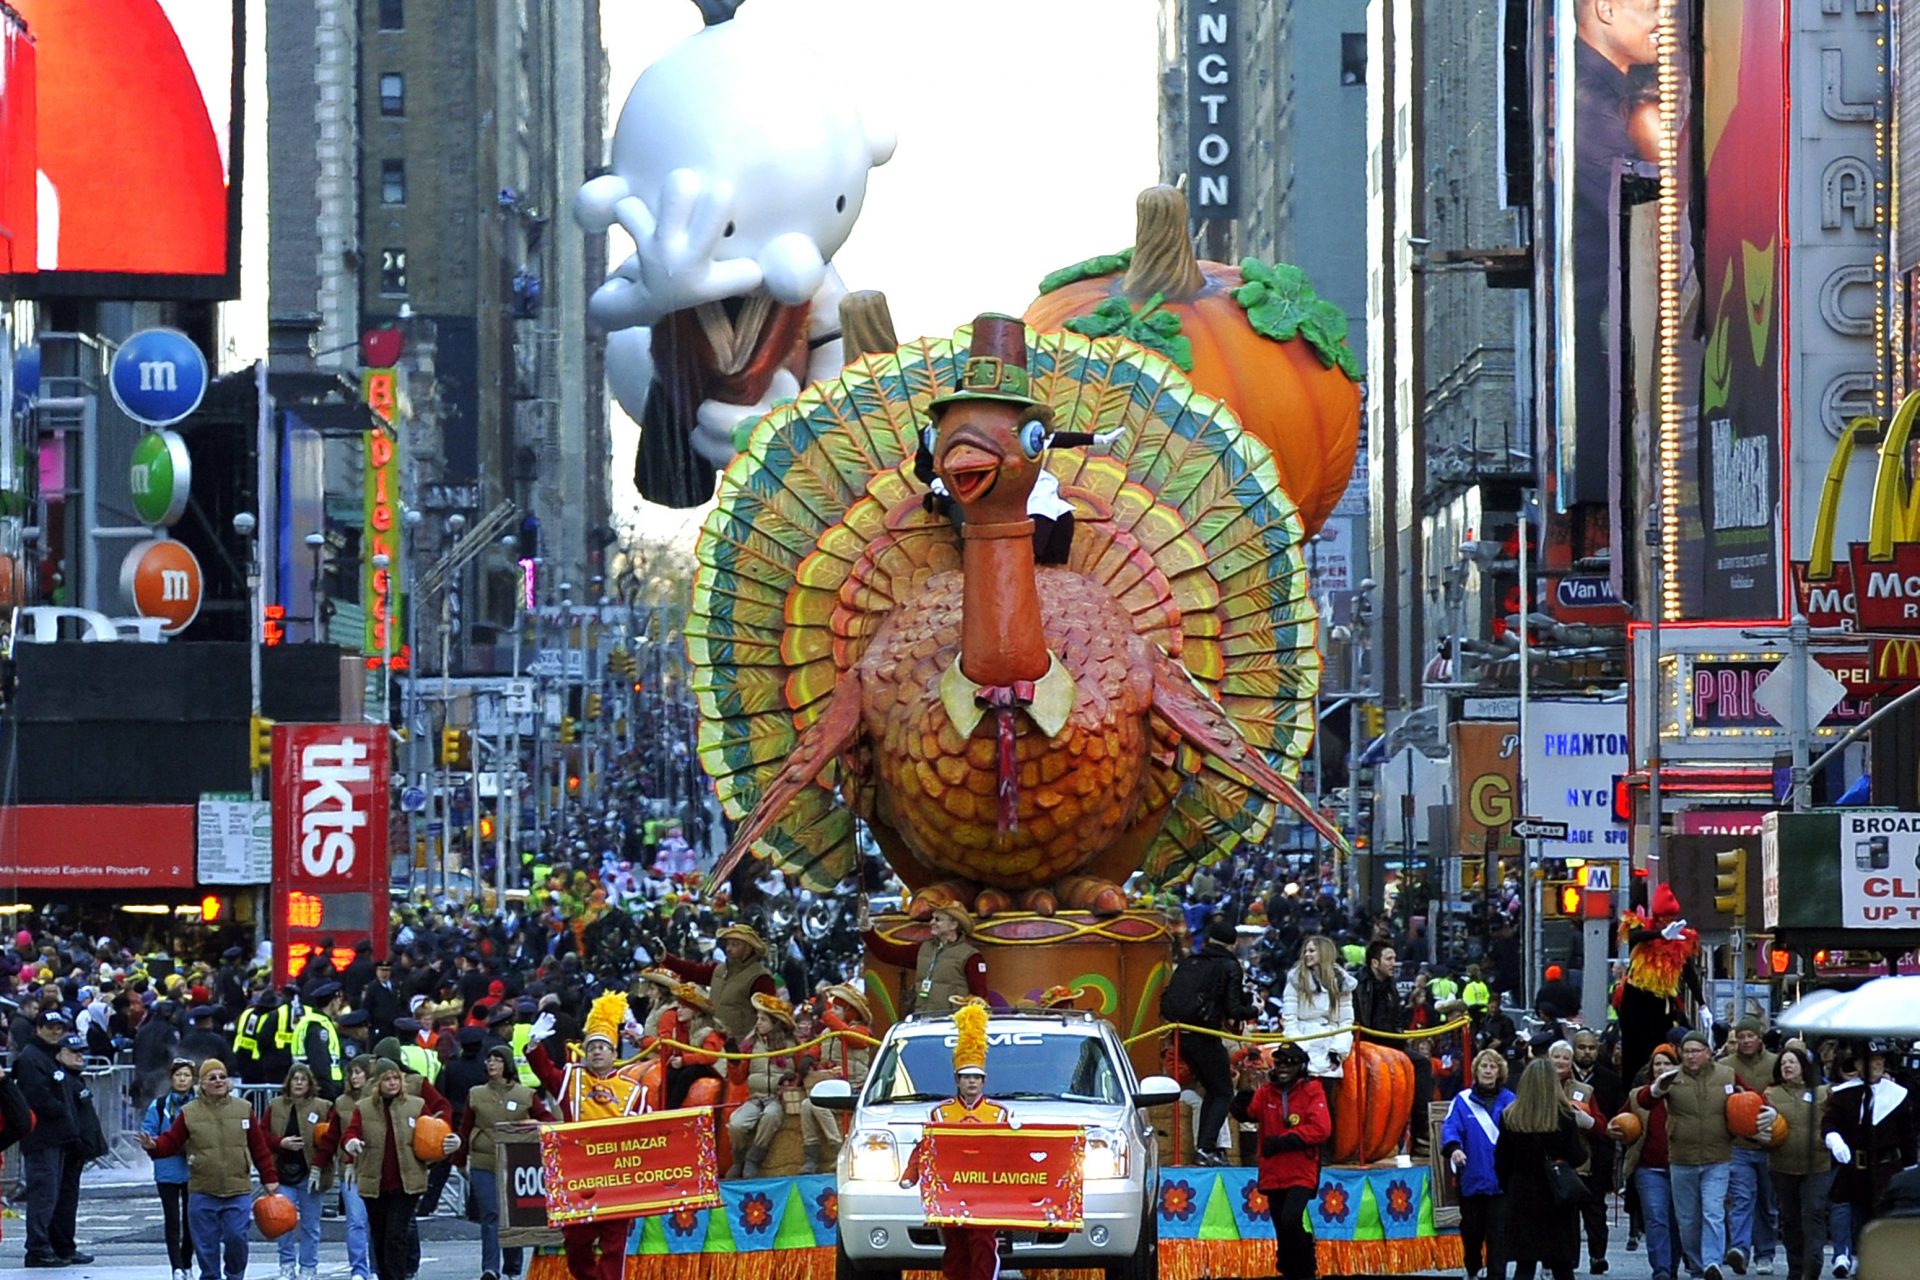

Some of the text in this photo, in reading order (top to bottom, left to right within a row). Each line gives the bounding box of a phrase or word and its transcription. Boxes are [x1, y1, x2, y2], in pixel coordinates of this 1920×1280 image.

[1198, 0, 1230, 206] NGTON
[1819, 0, 1875, 442] LACE
[1567, 581, 1596, 598] Van
[1828, 668, 1870, 684] PE
[301, 737, 370, 877] tkts
[1469, 773, 1512, 826] G
[1567, 788, 1608, 807] NYC
[62, 865, 103, 876] Equities
[106, 865, 150, 877] Property
[1863, 877, 1920, 898] CL
[1863, 907, 1898, 920] UP
[586, 1136, 668, 1157] DEBI MAZAR
[613, 1156, 642, 1169] AND
[567, 1166, 693, 1191] GABRIELE CORCOS
[952, 1171, 1048, 1186] AVRIL LAVIGNE
